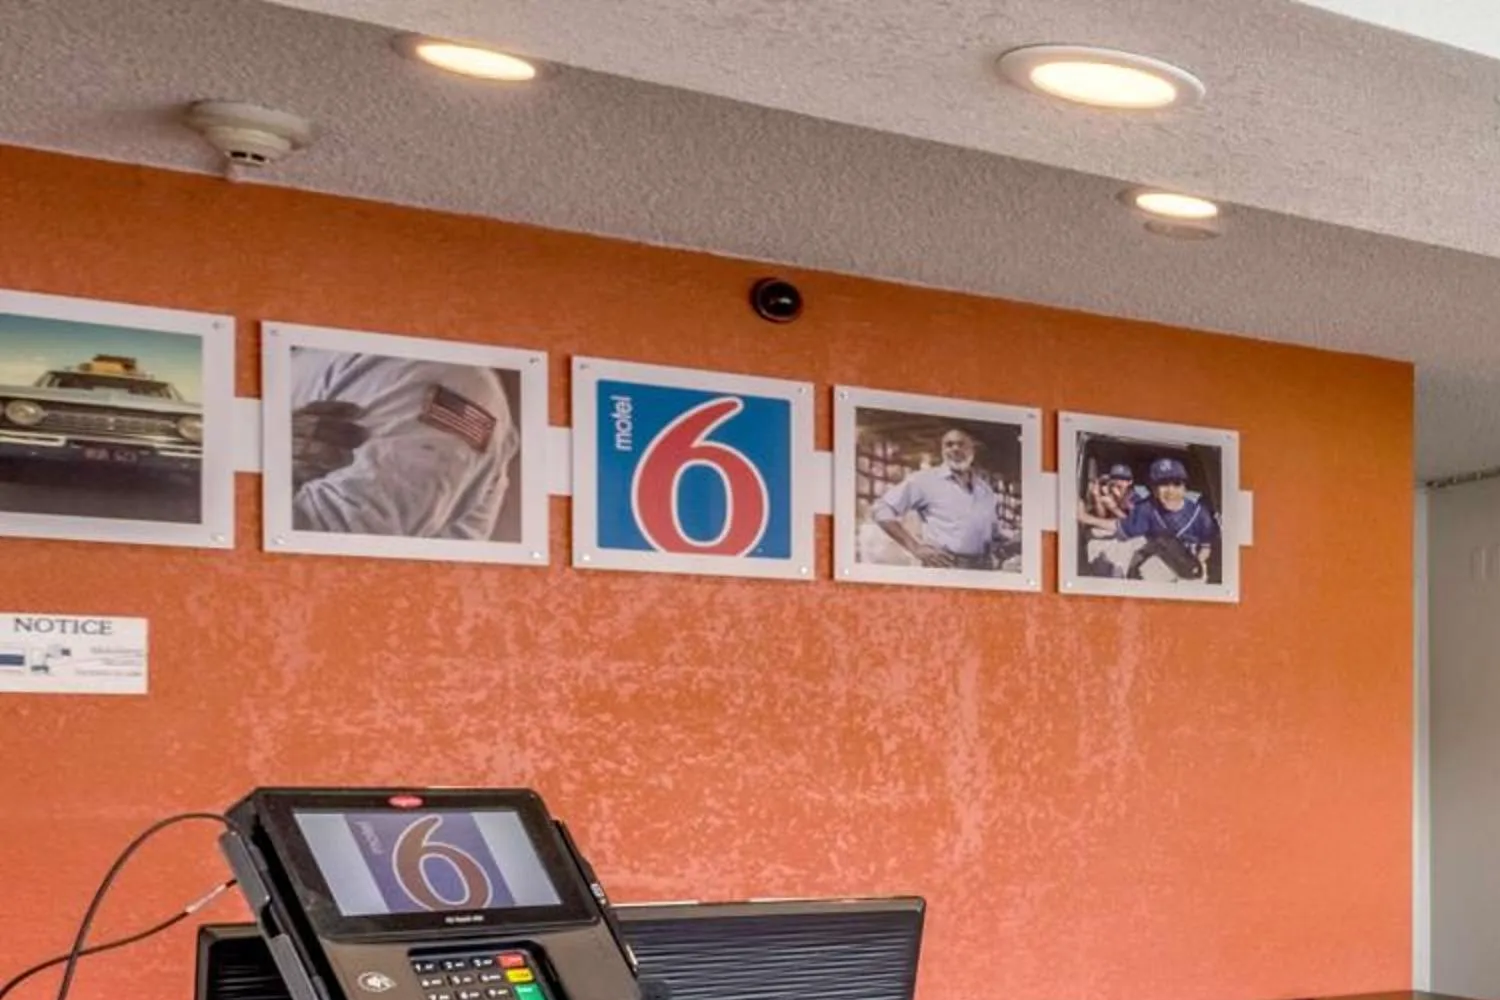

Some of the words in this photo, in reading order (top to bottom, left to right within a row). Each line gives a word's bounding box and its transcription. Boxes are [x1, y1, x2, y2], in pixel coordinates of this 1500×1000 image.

[610, 395, 633, 451] motel
[631, 396, 769, 557] 6
[13, 617, 113, 635] NOTICE
[392, 814, 493, 911] 6
